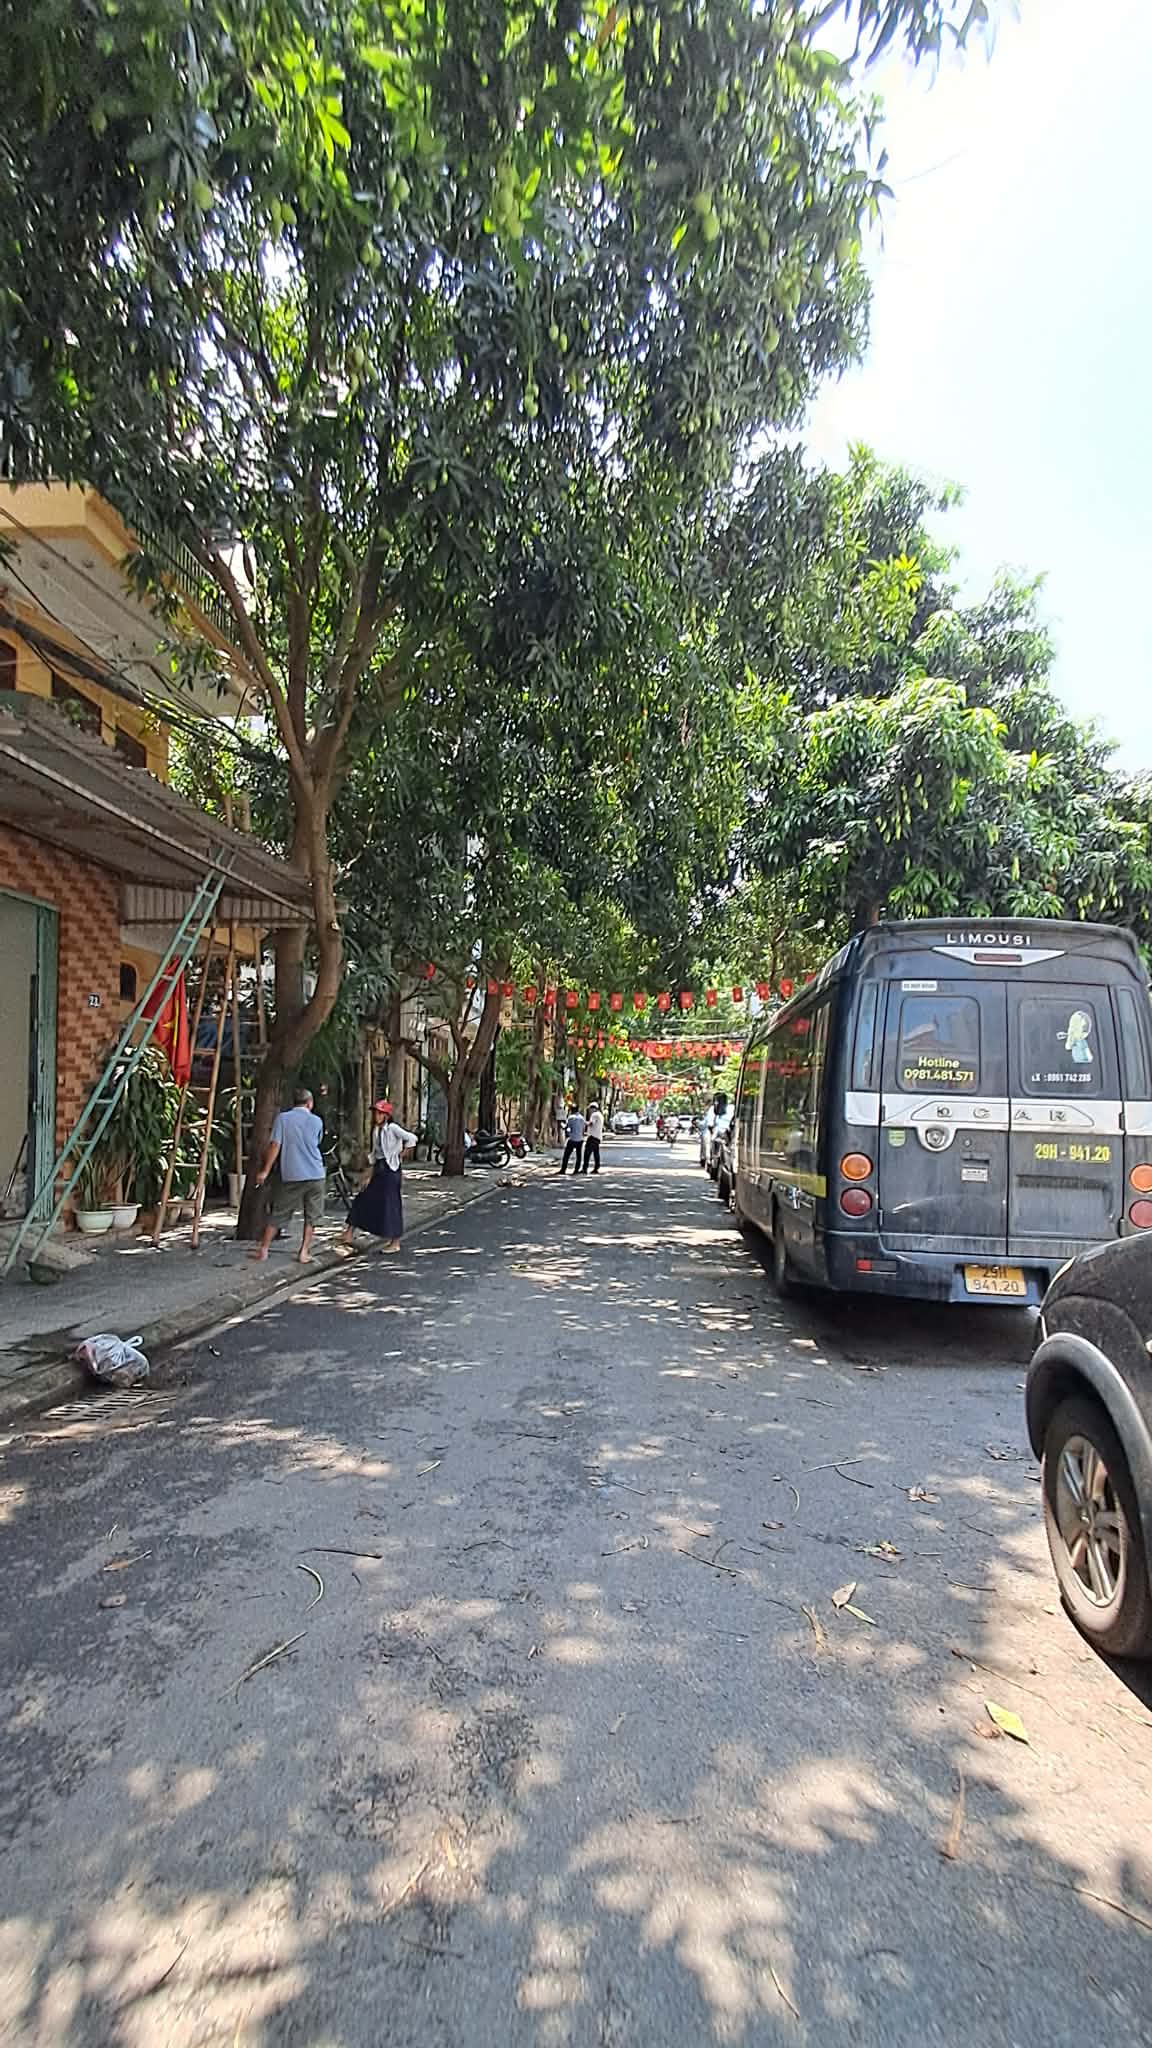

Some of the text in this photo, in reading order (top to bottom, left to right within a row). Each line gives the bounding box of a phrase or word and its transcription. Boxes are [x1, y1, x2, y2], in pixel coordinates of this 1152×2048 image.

[946, 933, 1031, 945] LIMOUSI
[918, 1056, 960, 1068] Hotline
[1034, 1143, 1058, 1159] 29H
[1070, 1145, 1111, 1161] 941.20
[983, 1265, 1008, 1278] 29H
[973, 1279, 1019, 1292] 941.20
